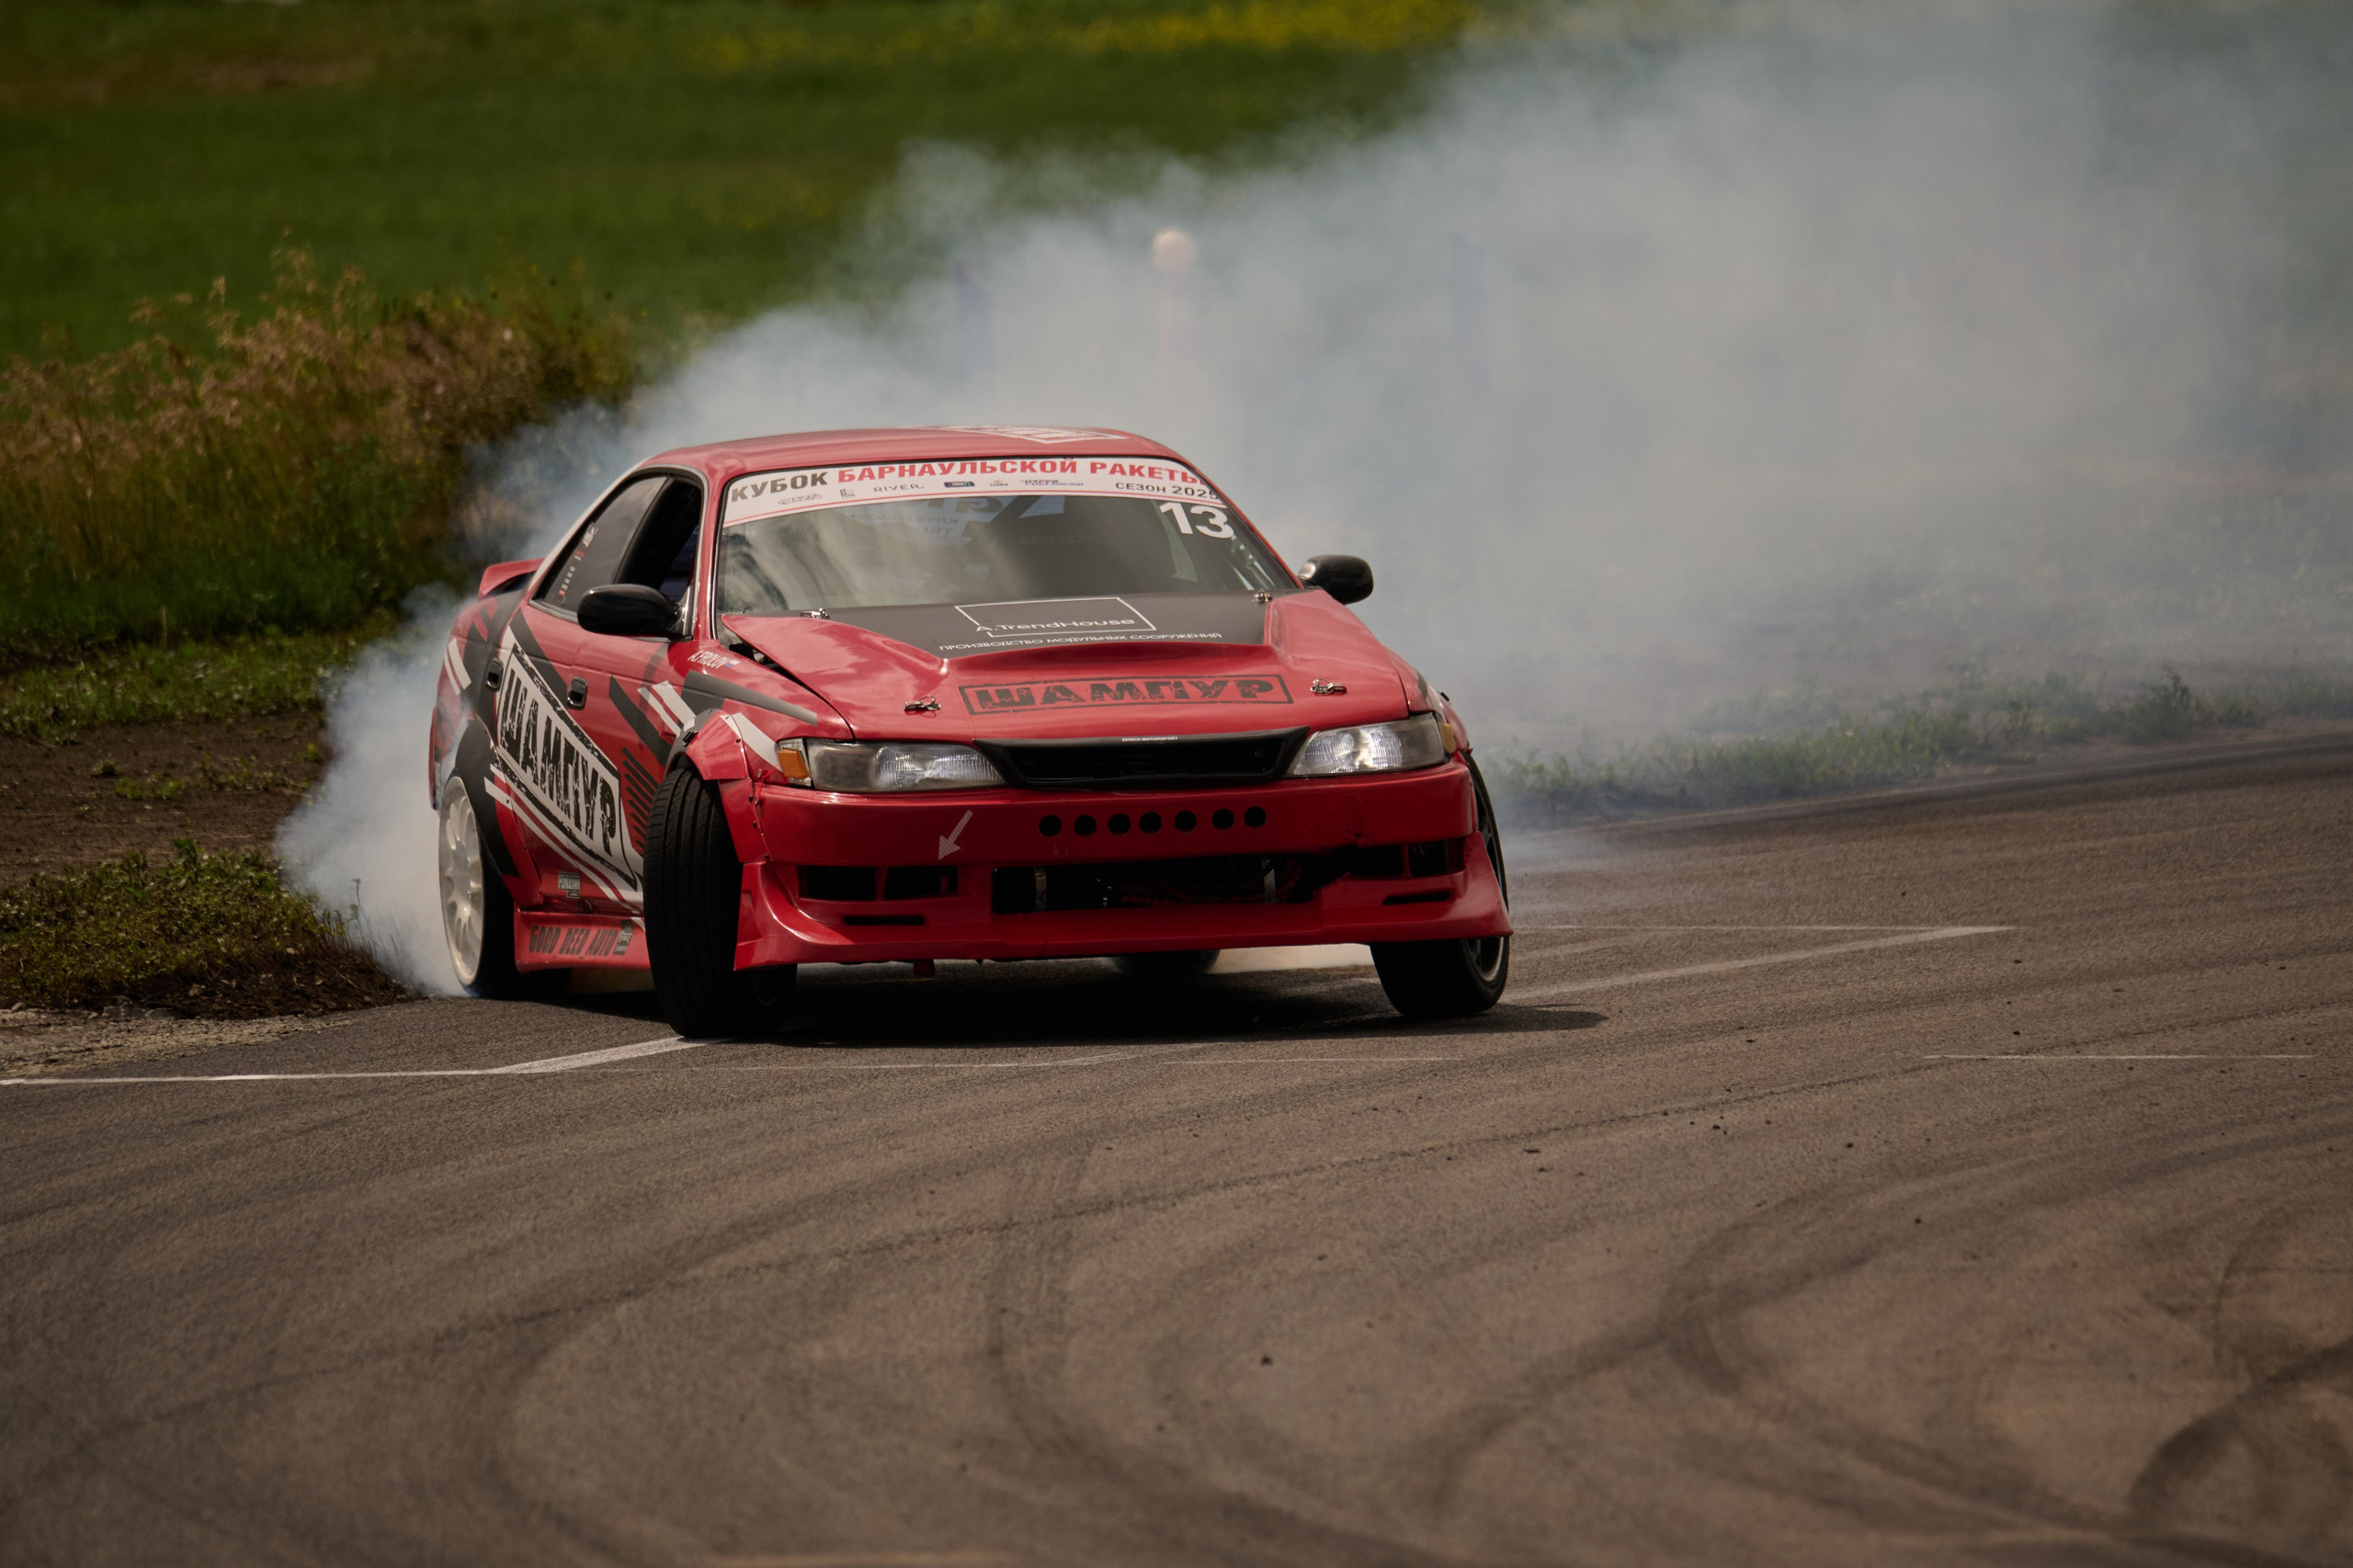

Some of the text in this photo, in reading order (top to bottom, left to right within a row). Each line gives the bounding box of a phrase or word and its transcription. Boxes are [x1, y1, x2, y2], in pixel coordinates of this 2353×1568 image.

[732, 472, 828, 503] КУБОК
[838, 458, 1077, 483] БАРНАУЛЬСКОЙ
[1090, 461, 1206, 485] РАКЕТЫ
[873, 483, 924, 493] RIVER
[1115, 483, 1219, 500] СЕЗОН 2025
[1159, 502, 1234, 540] 13
[976, 619, 1136, 632] A.TrendHouse
[938, 632, 1222, 652] ПРОИЗВОДСТВО МОДУЛЬНЫХ СООРУЖЕНИЙ
[974, 678, 1275, 710] ШАМПУР
[499, 668, 617, 858] ШАМПУР
[529, 925, 562, 955] GOOD
[558, 927, 591, 955] DEED
[585, 928, 620, 957] AUTO
